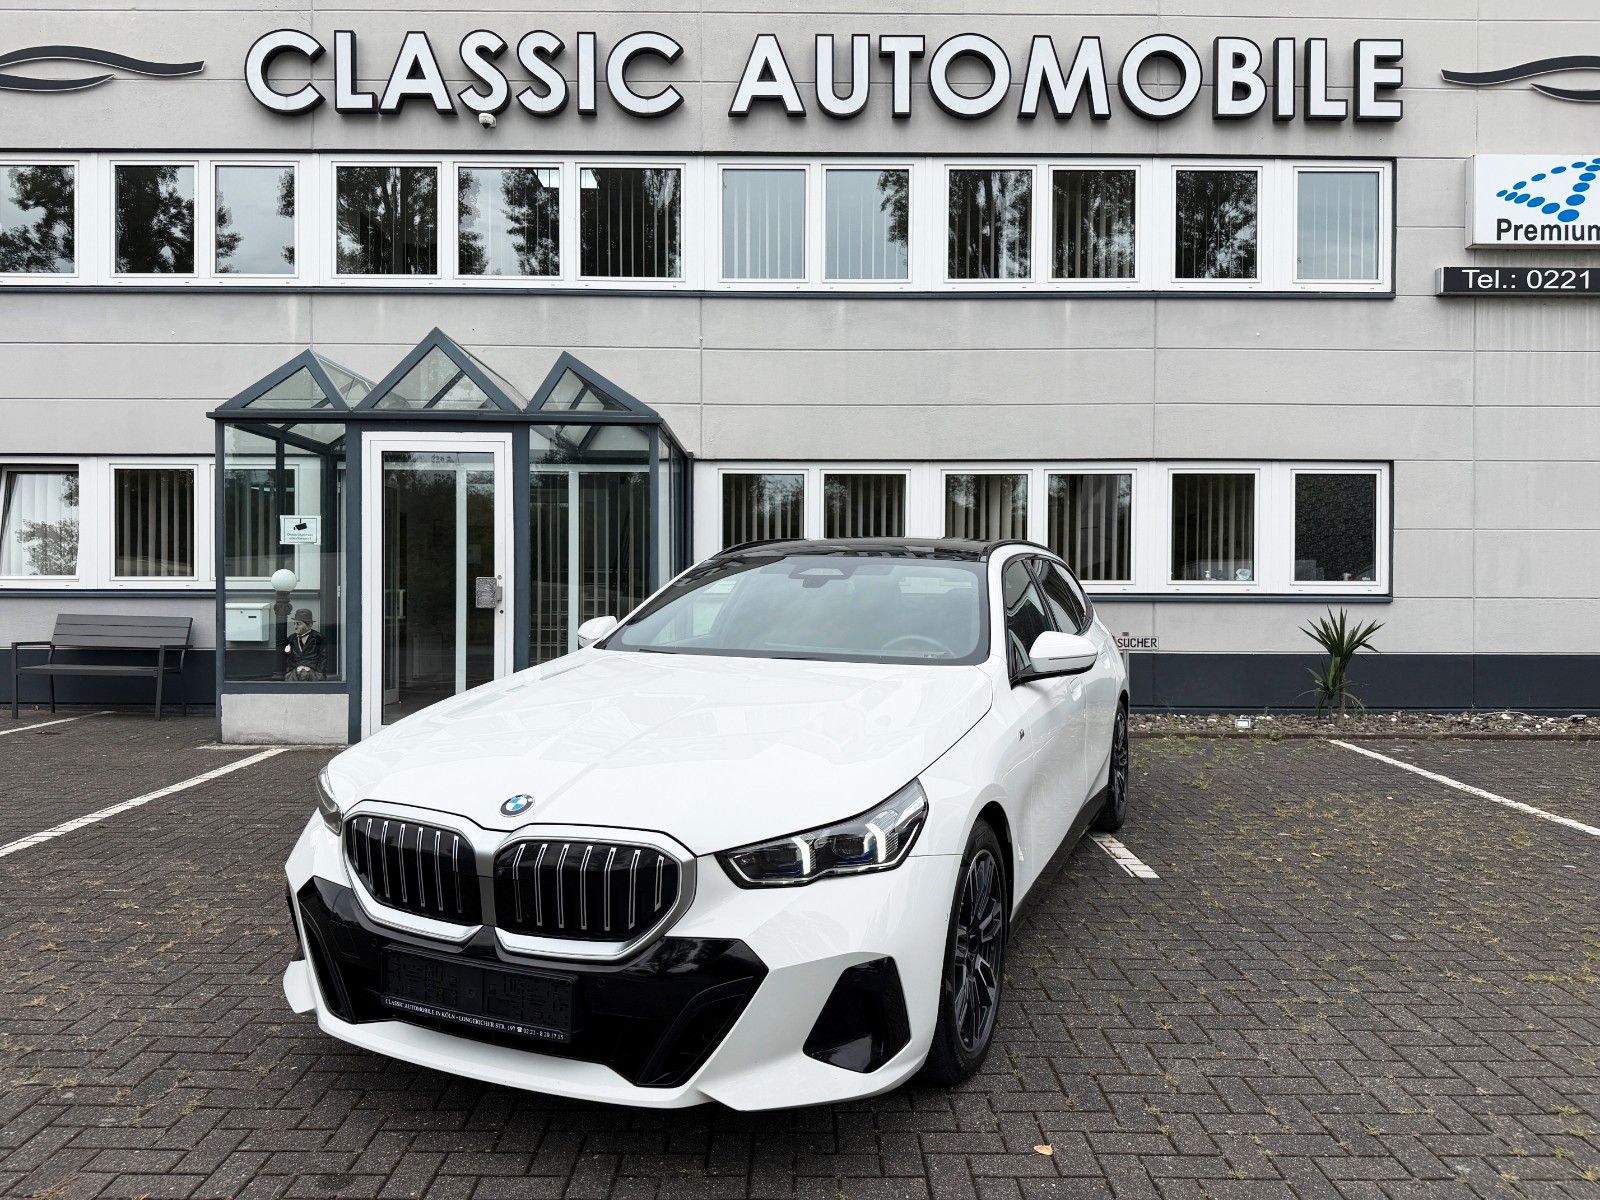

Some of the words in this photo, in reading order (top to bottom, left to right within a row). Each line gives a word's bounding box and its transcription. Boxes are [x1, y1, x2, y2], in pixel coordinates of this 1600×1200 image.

[244, 28, 686, 118] CLASSIC
[728, 33, 1404, 123] AUTOMOBILE
[1462, 269, 1516, 289] Tel.:
[1526, 269, 1590, 290] 0221
[1117, 637, 1157, 648] SUCHER
[404, 1004, 435, 1016] AUTOMOBILE
